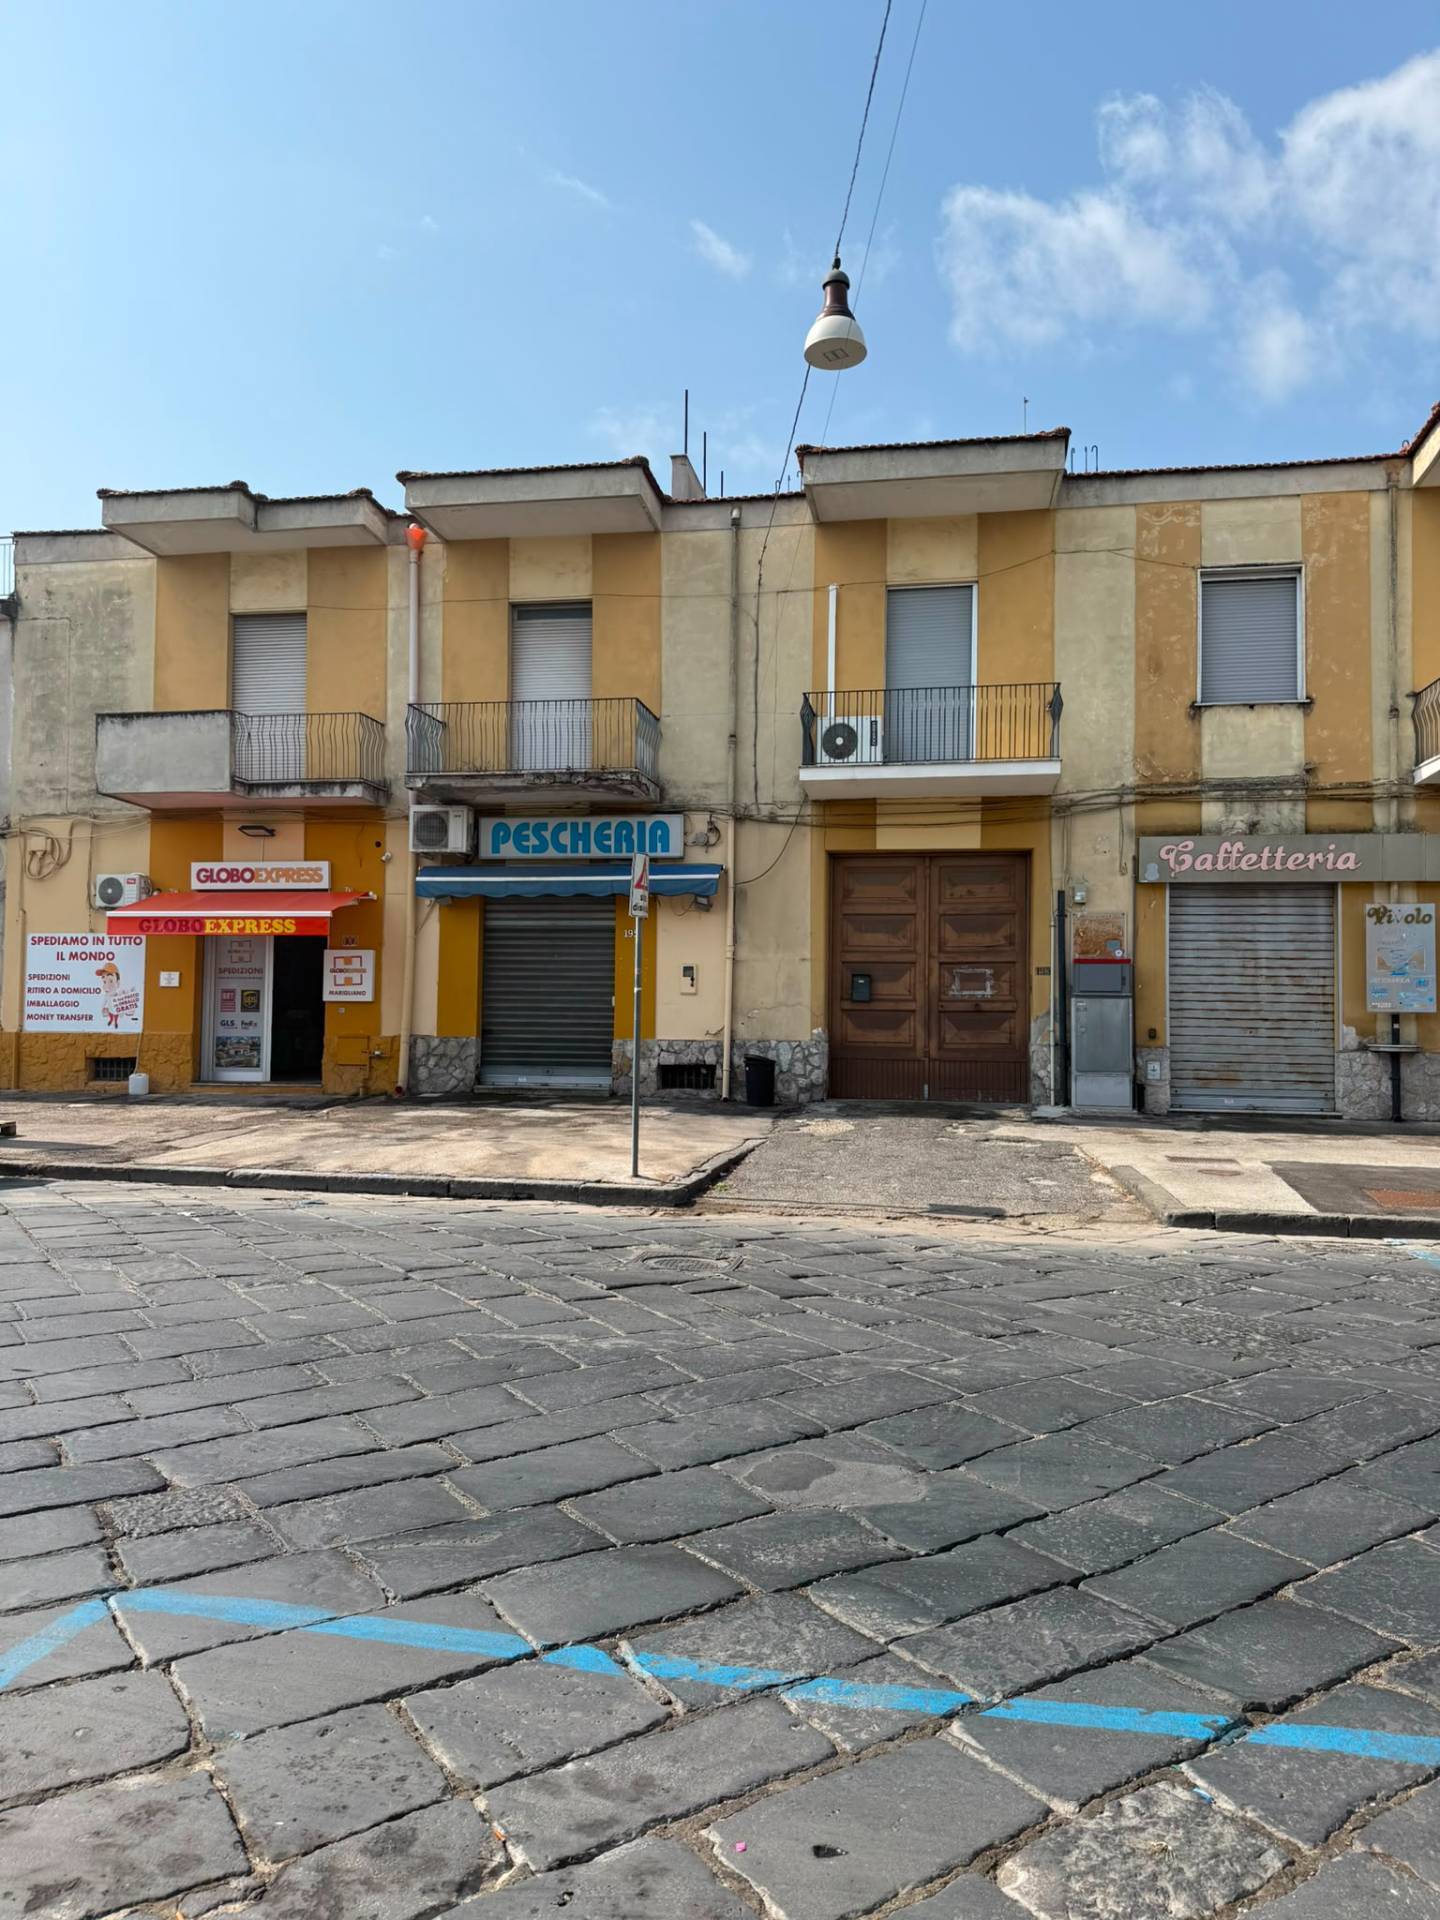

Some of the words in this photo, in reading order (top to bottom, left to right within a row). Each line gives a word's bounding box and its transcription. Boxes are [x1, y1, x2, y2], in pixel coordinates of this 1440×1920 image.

[491, 820, 670, 854] PESCHERIA
[1160, 841, 1361, 873] Caffetteria
[31, 936, 88, 946] SPEDIAMO
[92, 936, 105, 946] IN
[108, 936, 143, 946] TUTTO
[56, 951, 65, 961] IL
[69, 951, 115, 961] MONDO
[218, 967, 263, 975] SPEDIZIONI
[28, 974, 71, 982] SPEDIZIONI
[27, 987, 52, 995] RITIRO
[53, 987, 59, 995] A
[61, 987, 102, 995] DOMICILIO
[26, 1000, 80, 1008] IMBALLAGGIO
[115, 1003, 138, 1013] GRATIS
